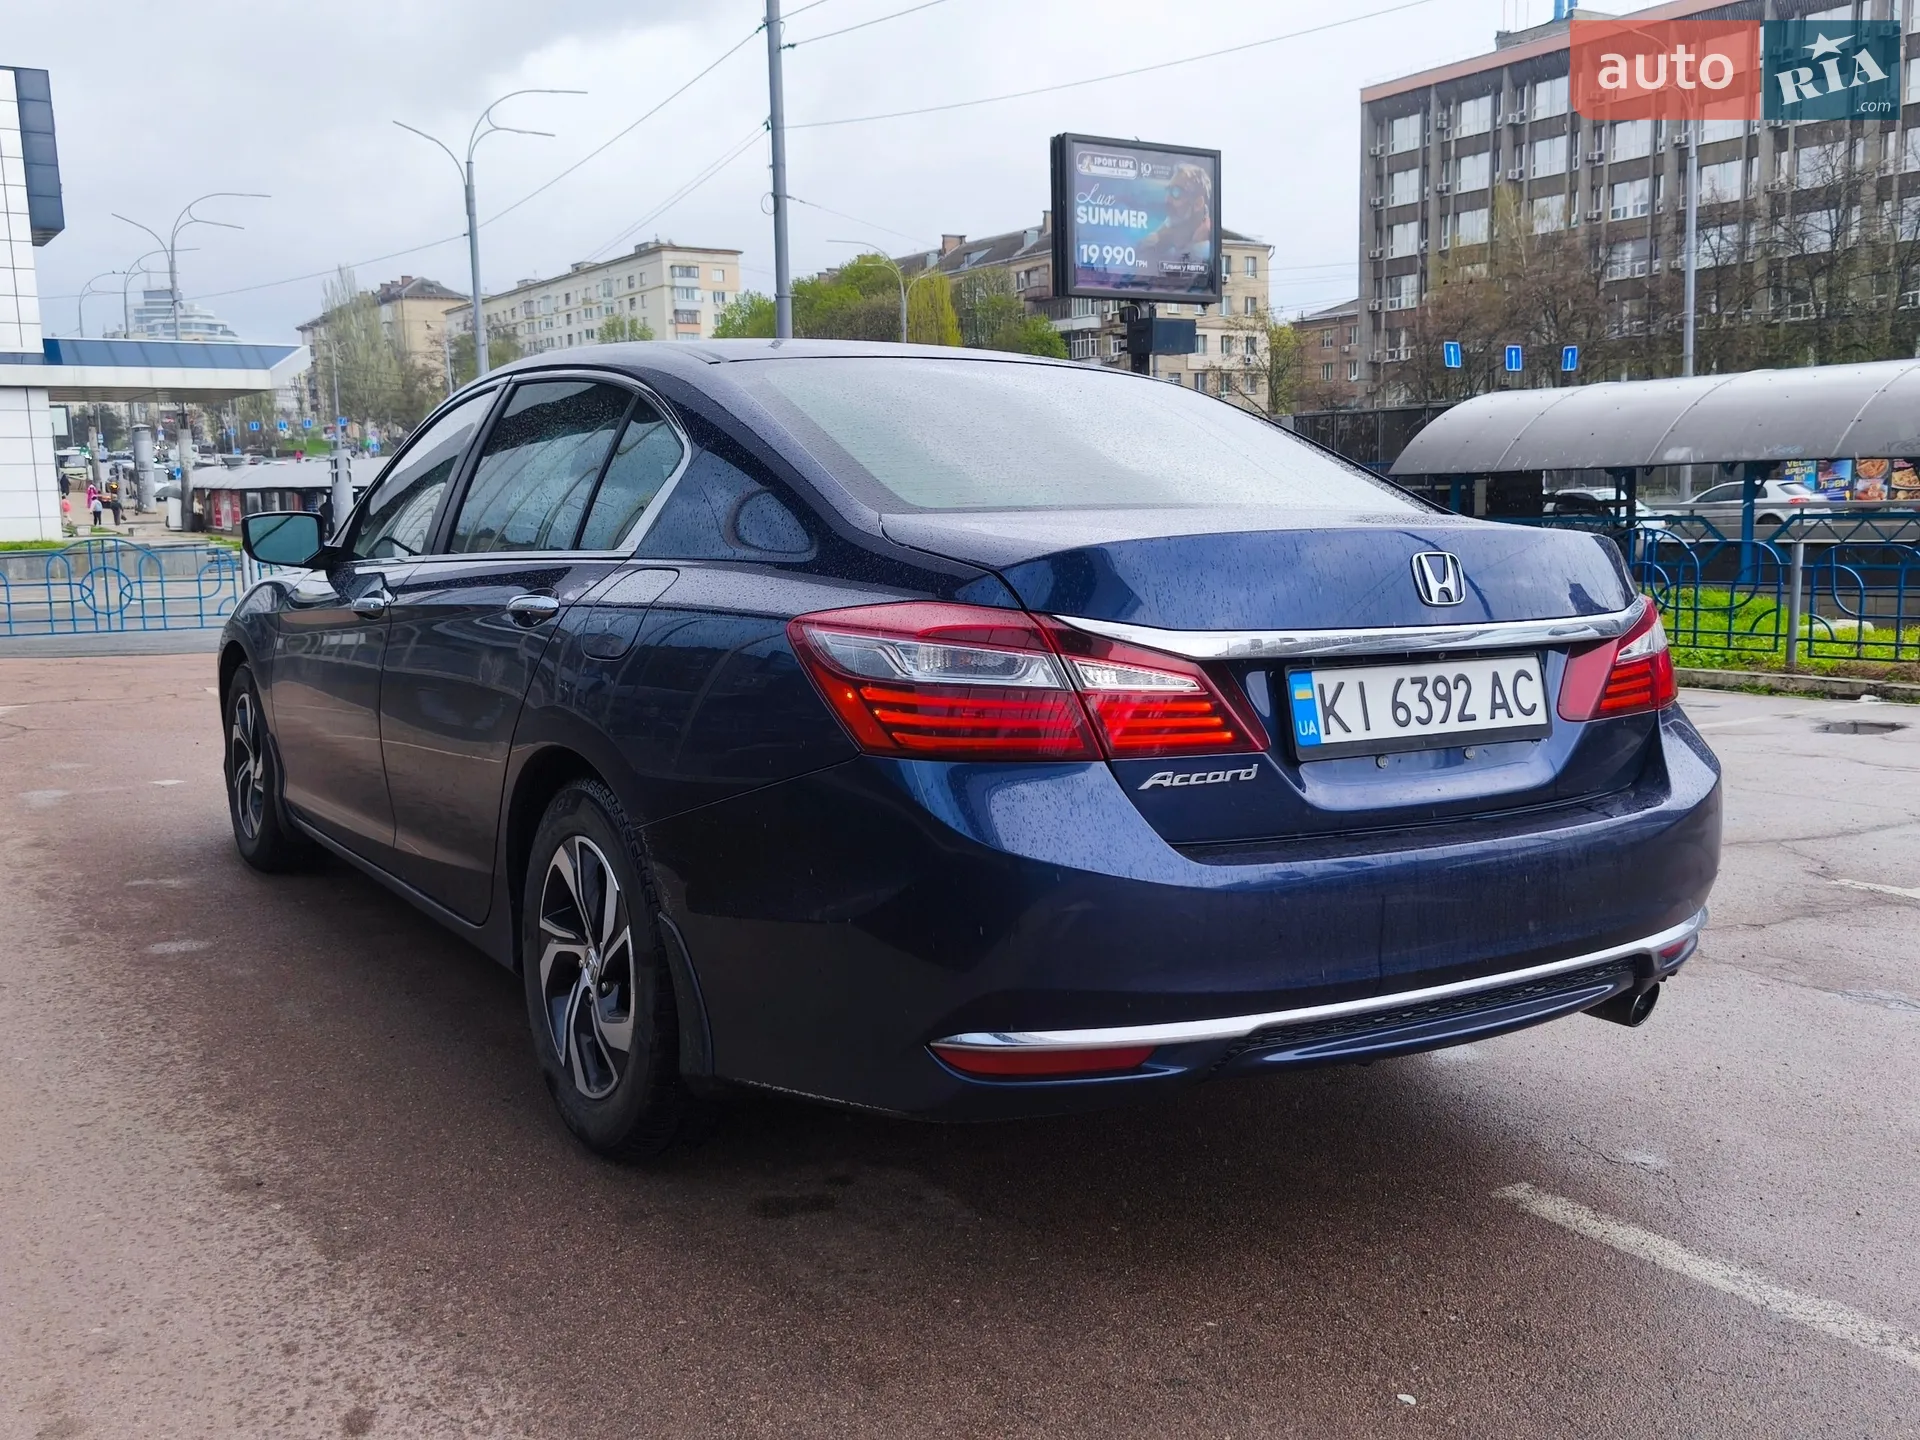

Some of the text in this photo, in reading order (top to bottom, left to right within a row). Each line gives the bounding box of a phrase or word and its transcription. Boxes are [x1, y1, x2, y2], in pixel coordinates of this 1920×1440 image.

[1076, 183, 1116, 206] Lux
[1076, 206, 1148, 229] SUMMER
[1080, 244, 1099, 264] 19
[1102, 246, 1136, 266] 990
[1318, 669, 1537, 735] KI 6392 AC
[1299, 720, 1318, 736] UA
[1138, 764, 1258, 790] Accord
